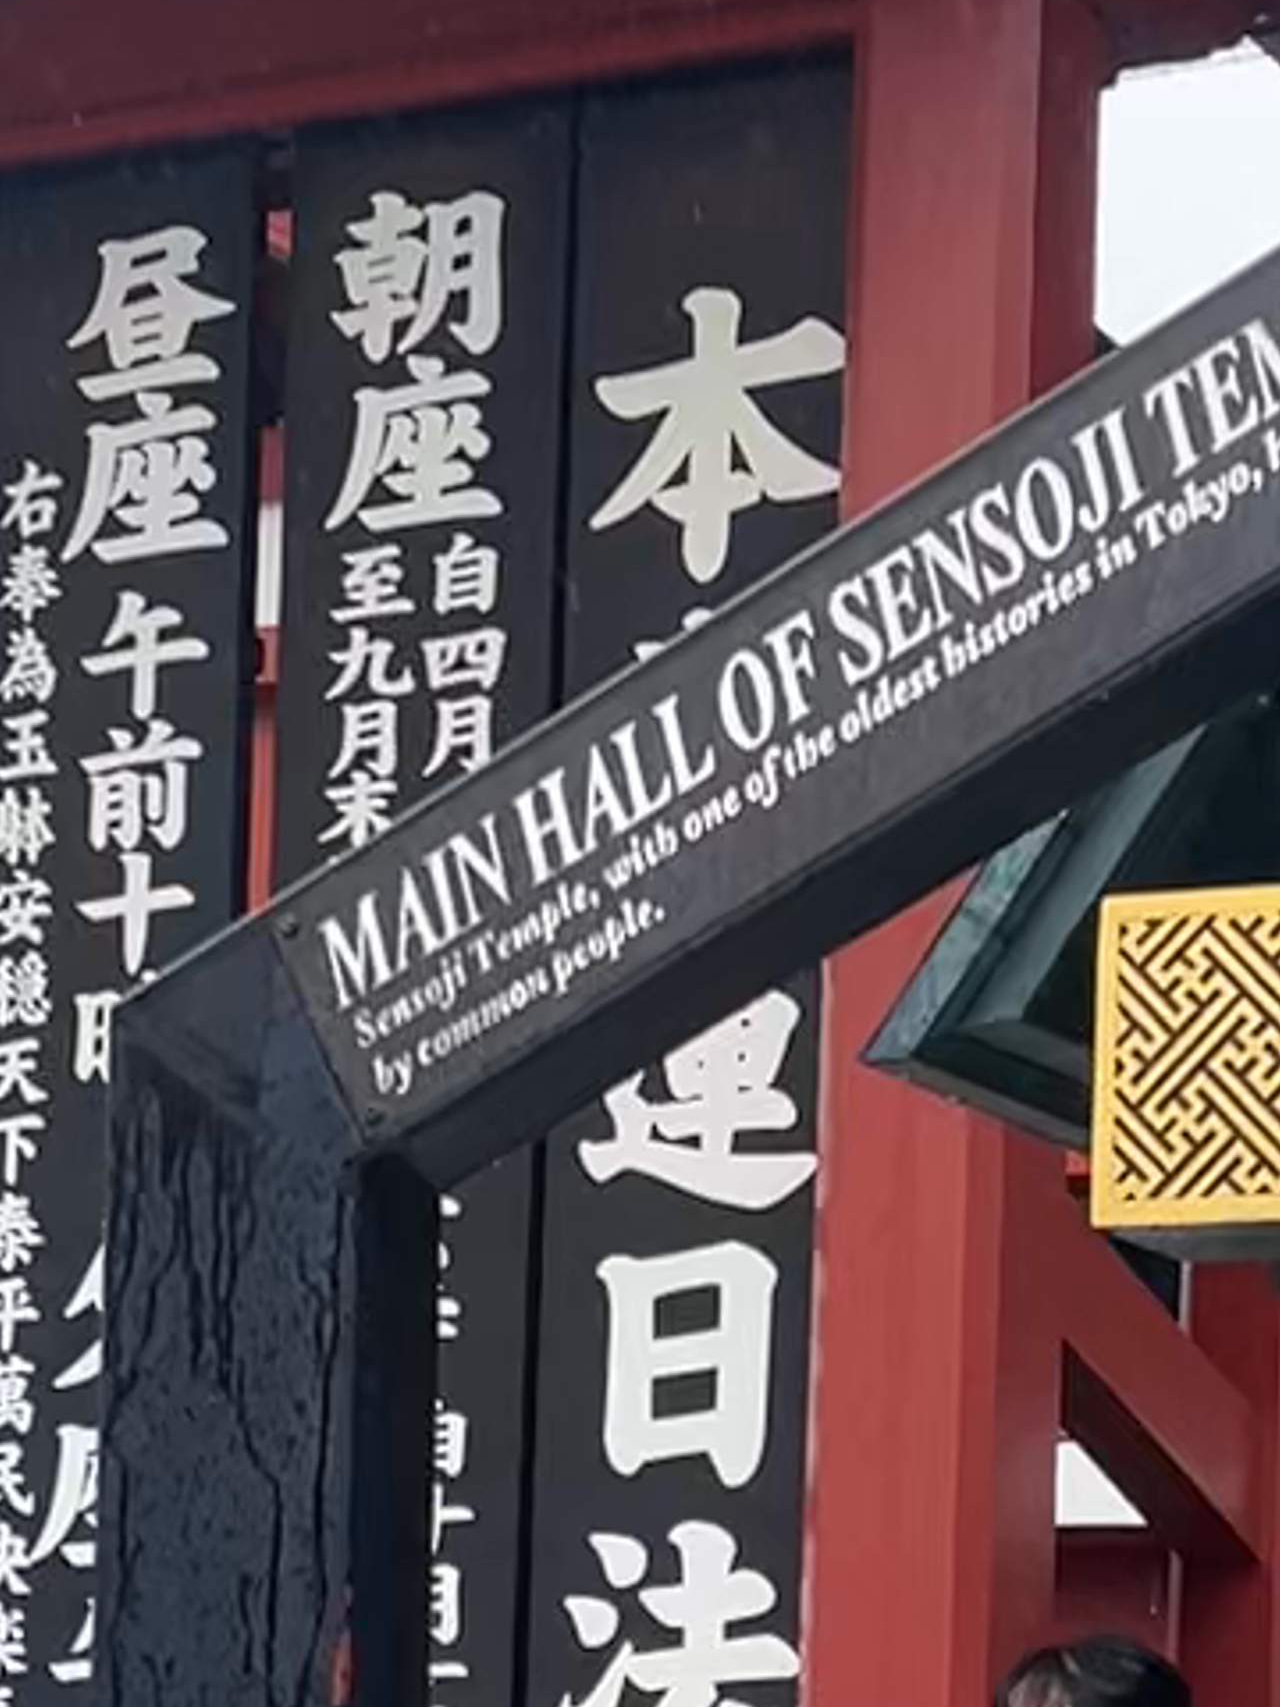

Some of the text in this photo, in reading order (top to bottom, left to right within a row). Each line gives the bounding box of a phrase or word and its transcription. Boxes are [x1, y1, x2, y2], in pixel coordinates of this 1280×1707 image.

[326, 193, 505, 532] 朝座
[319, 813, 512, 1010] MAIN
[514, 694, 716, 886] HALL
[719, 610, 815, 750] OF
[828, 406, 1145, 687] SENSOJI
[353, 949, 467, 1047] Sensoji
[467, 881, 600, 976] Temple,
[603, 822, 679, 890] with
[683, 786, 741, 841] one
[743, 742, 784, 807] of
[783, 719, 836, 780] the
[840, 659, 940, 742] oldest
[940, 561, 1095, 678] histories
[1096, 529, 1138, 578] in
[1134, 460, 1265, 550] Tokyo,
[372, 899, 666, 1096] by common people.
